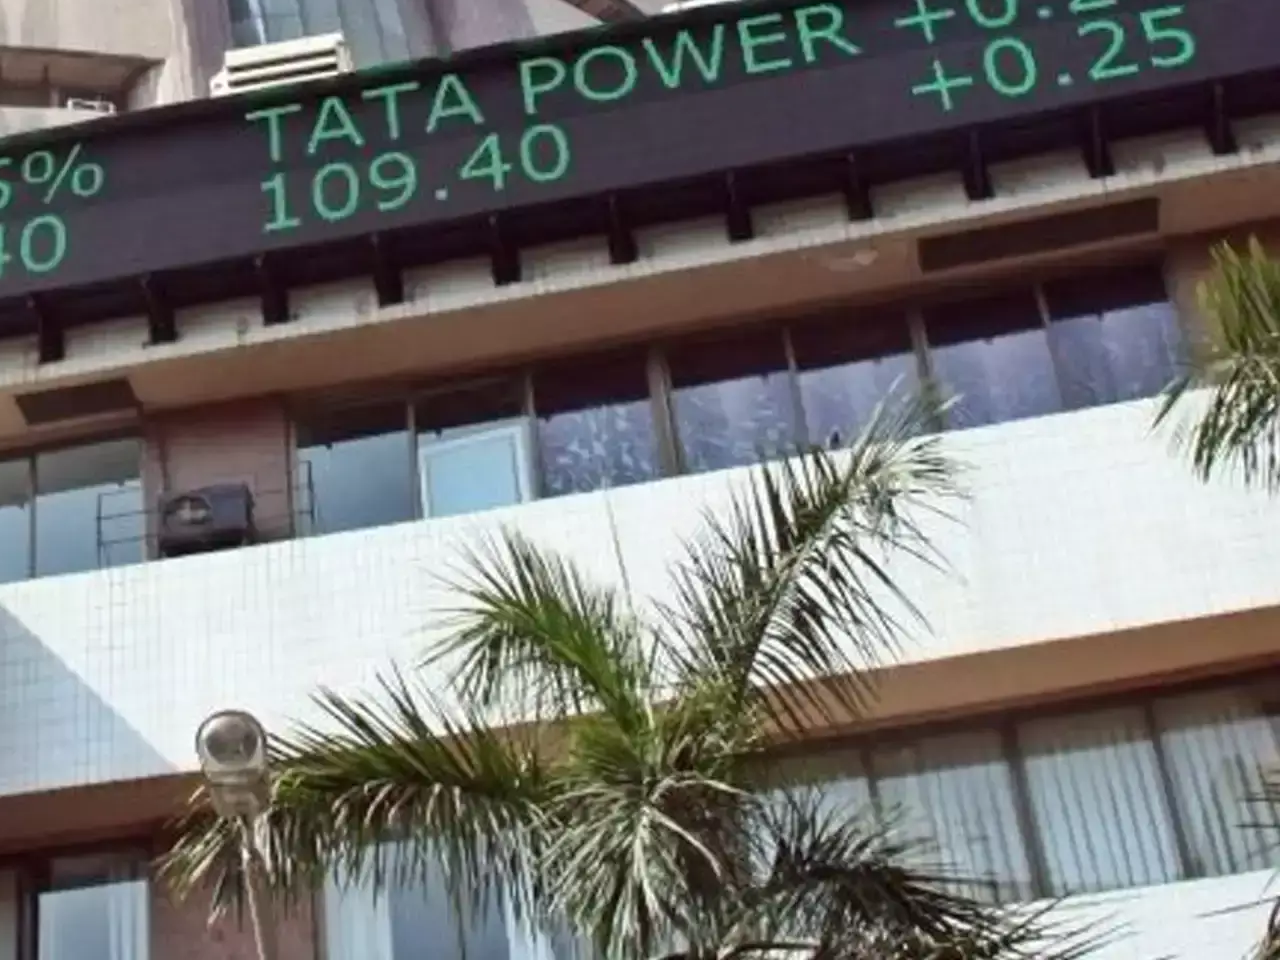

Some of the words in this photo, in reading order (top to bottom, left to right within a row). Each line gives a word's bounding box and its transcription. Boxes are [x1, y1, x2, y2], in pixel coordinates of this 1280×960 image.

[246, 73, 484, 161] TATA
[521, 2, 861, 115] POWER
[261, 124, 570, 233] 109.40
[912, 5, 1196, 111] +0.25
